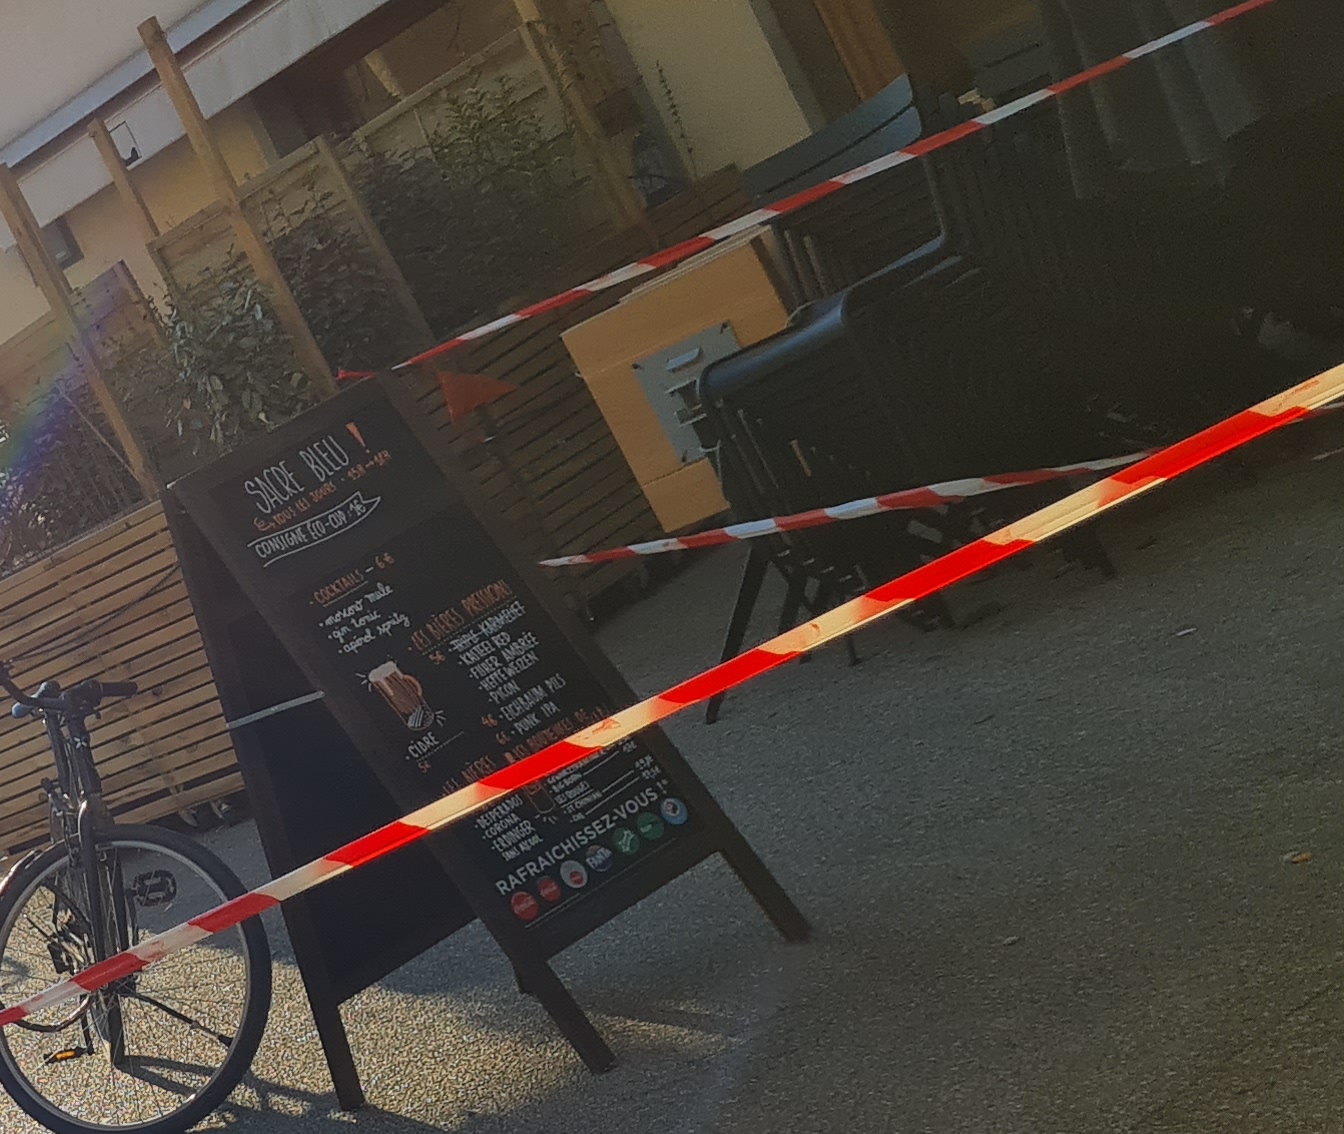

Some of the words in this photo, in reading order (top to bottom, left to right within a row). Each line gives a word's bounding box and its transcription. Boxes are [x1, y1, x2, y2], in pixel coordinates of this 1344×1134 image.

[244, 460, 305, 513] SACRE
[299, 435, 349, 482] BLEU
[272, 505, 297, 526] TOUS
[295, 497, 311, 512] LES
[309, 481, 337, 502] JOURS
[255, 526, 308, 558] CONSIGNE
[313, 569, 364, 604] COCKTAILS
[364, 582, 393, 603] mule
[332, 626, 351, 643] gin
[350, 609, 381, 629] tonic
[411, 630, 431, 650] LES
[491, 632, 512, 648] RED
[501, 631, 540, 663] AMBRÉE
[490, 681, 521, 704] PICON
[500, 686, 548, 722] EICHBAUM
[544, 673, 566, 694] PILS
[514, 712, 541, 735] PUNK
[541, 701, 560, 718] IPA
[407, 731, 439, 759] CIDRE
[476, 793, 524, 830] DESPERADOS
[485, 813, 522, 840] CORONA
[493, 820, 537, 853] ERDINGER
